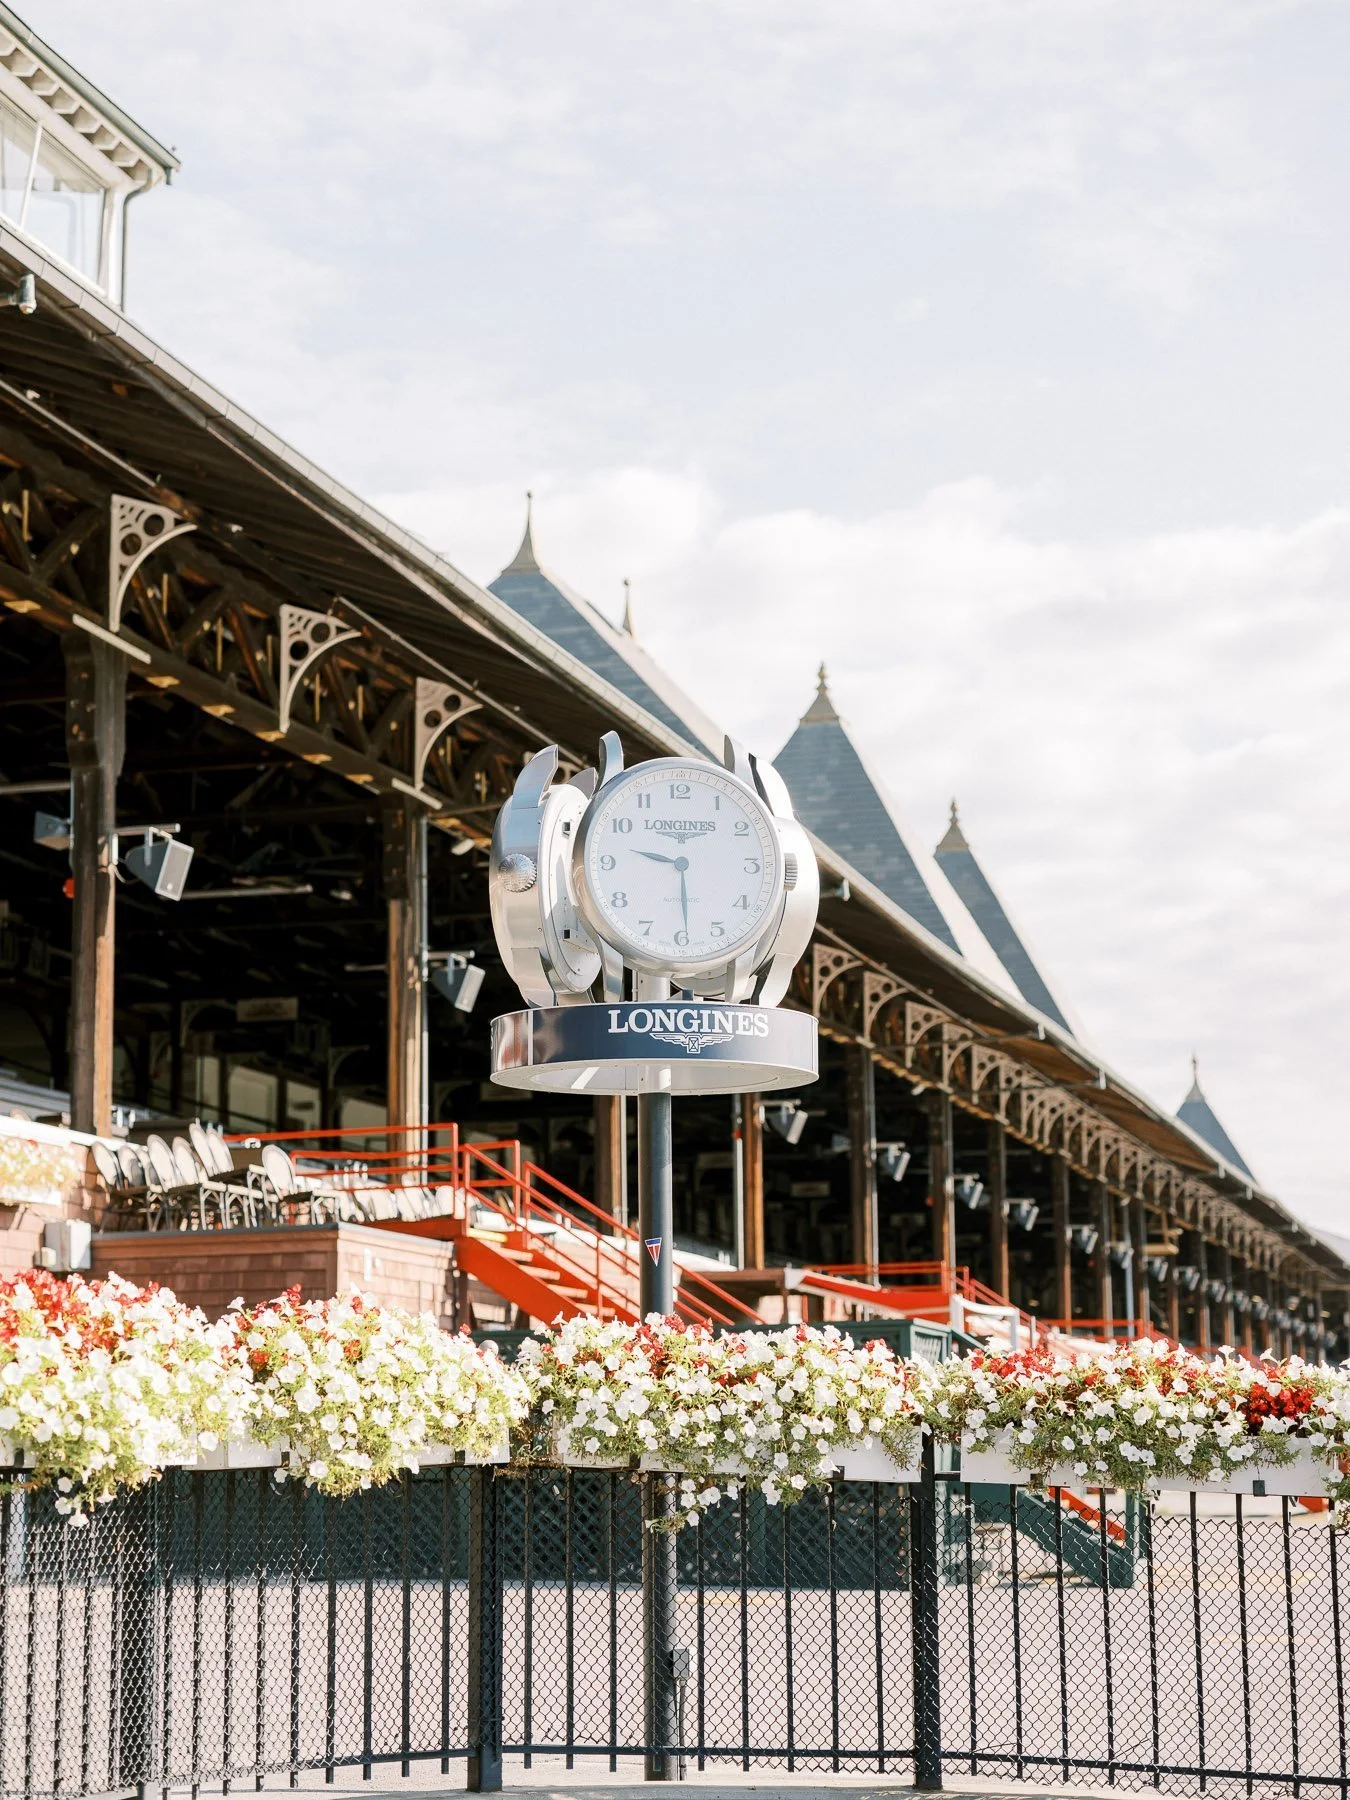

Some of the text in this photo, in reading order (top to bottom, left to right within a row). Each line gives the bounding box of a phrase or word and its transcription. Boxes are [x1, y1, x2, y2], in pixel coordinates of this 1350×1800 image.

[670, 784, 690, 799] 12
[637, 793, 650, 808] 11
[714, 794, 722, 811] 1
[612, 818, 632, 833] 10
[644, 820, 715, 831] LONGINES
[734, 821, 750, 836] 2
[600, 855, 616, 871] 9
[744, 858, 760, 874] 3
[611, 892, 628, 908] 8
[733, 895, 750, 910] 4
[638, 920, 653, 936] 7
[711, 922, 725, 937] 5
[674, 930, 689, 946] 6
[608, 1009, 769, 1037] LONGINES
